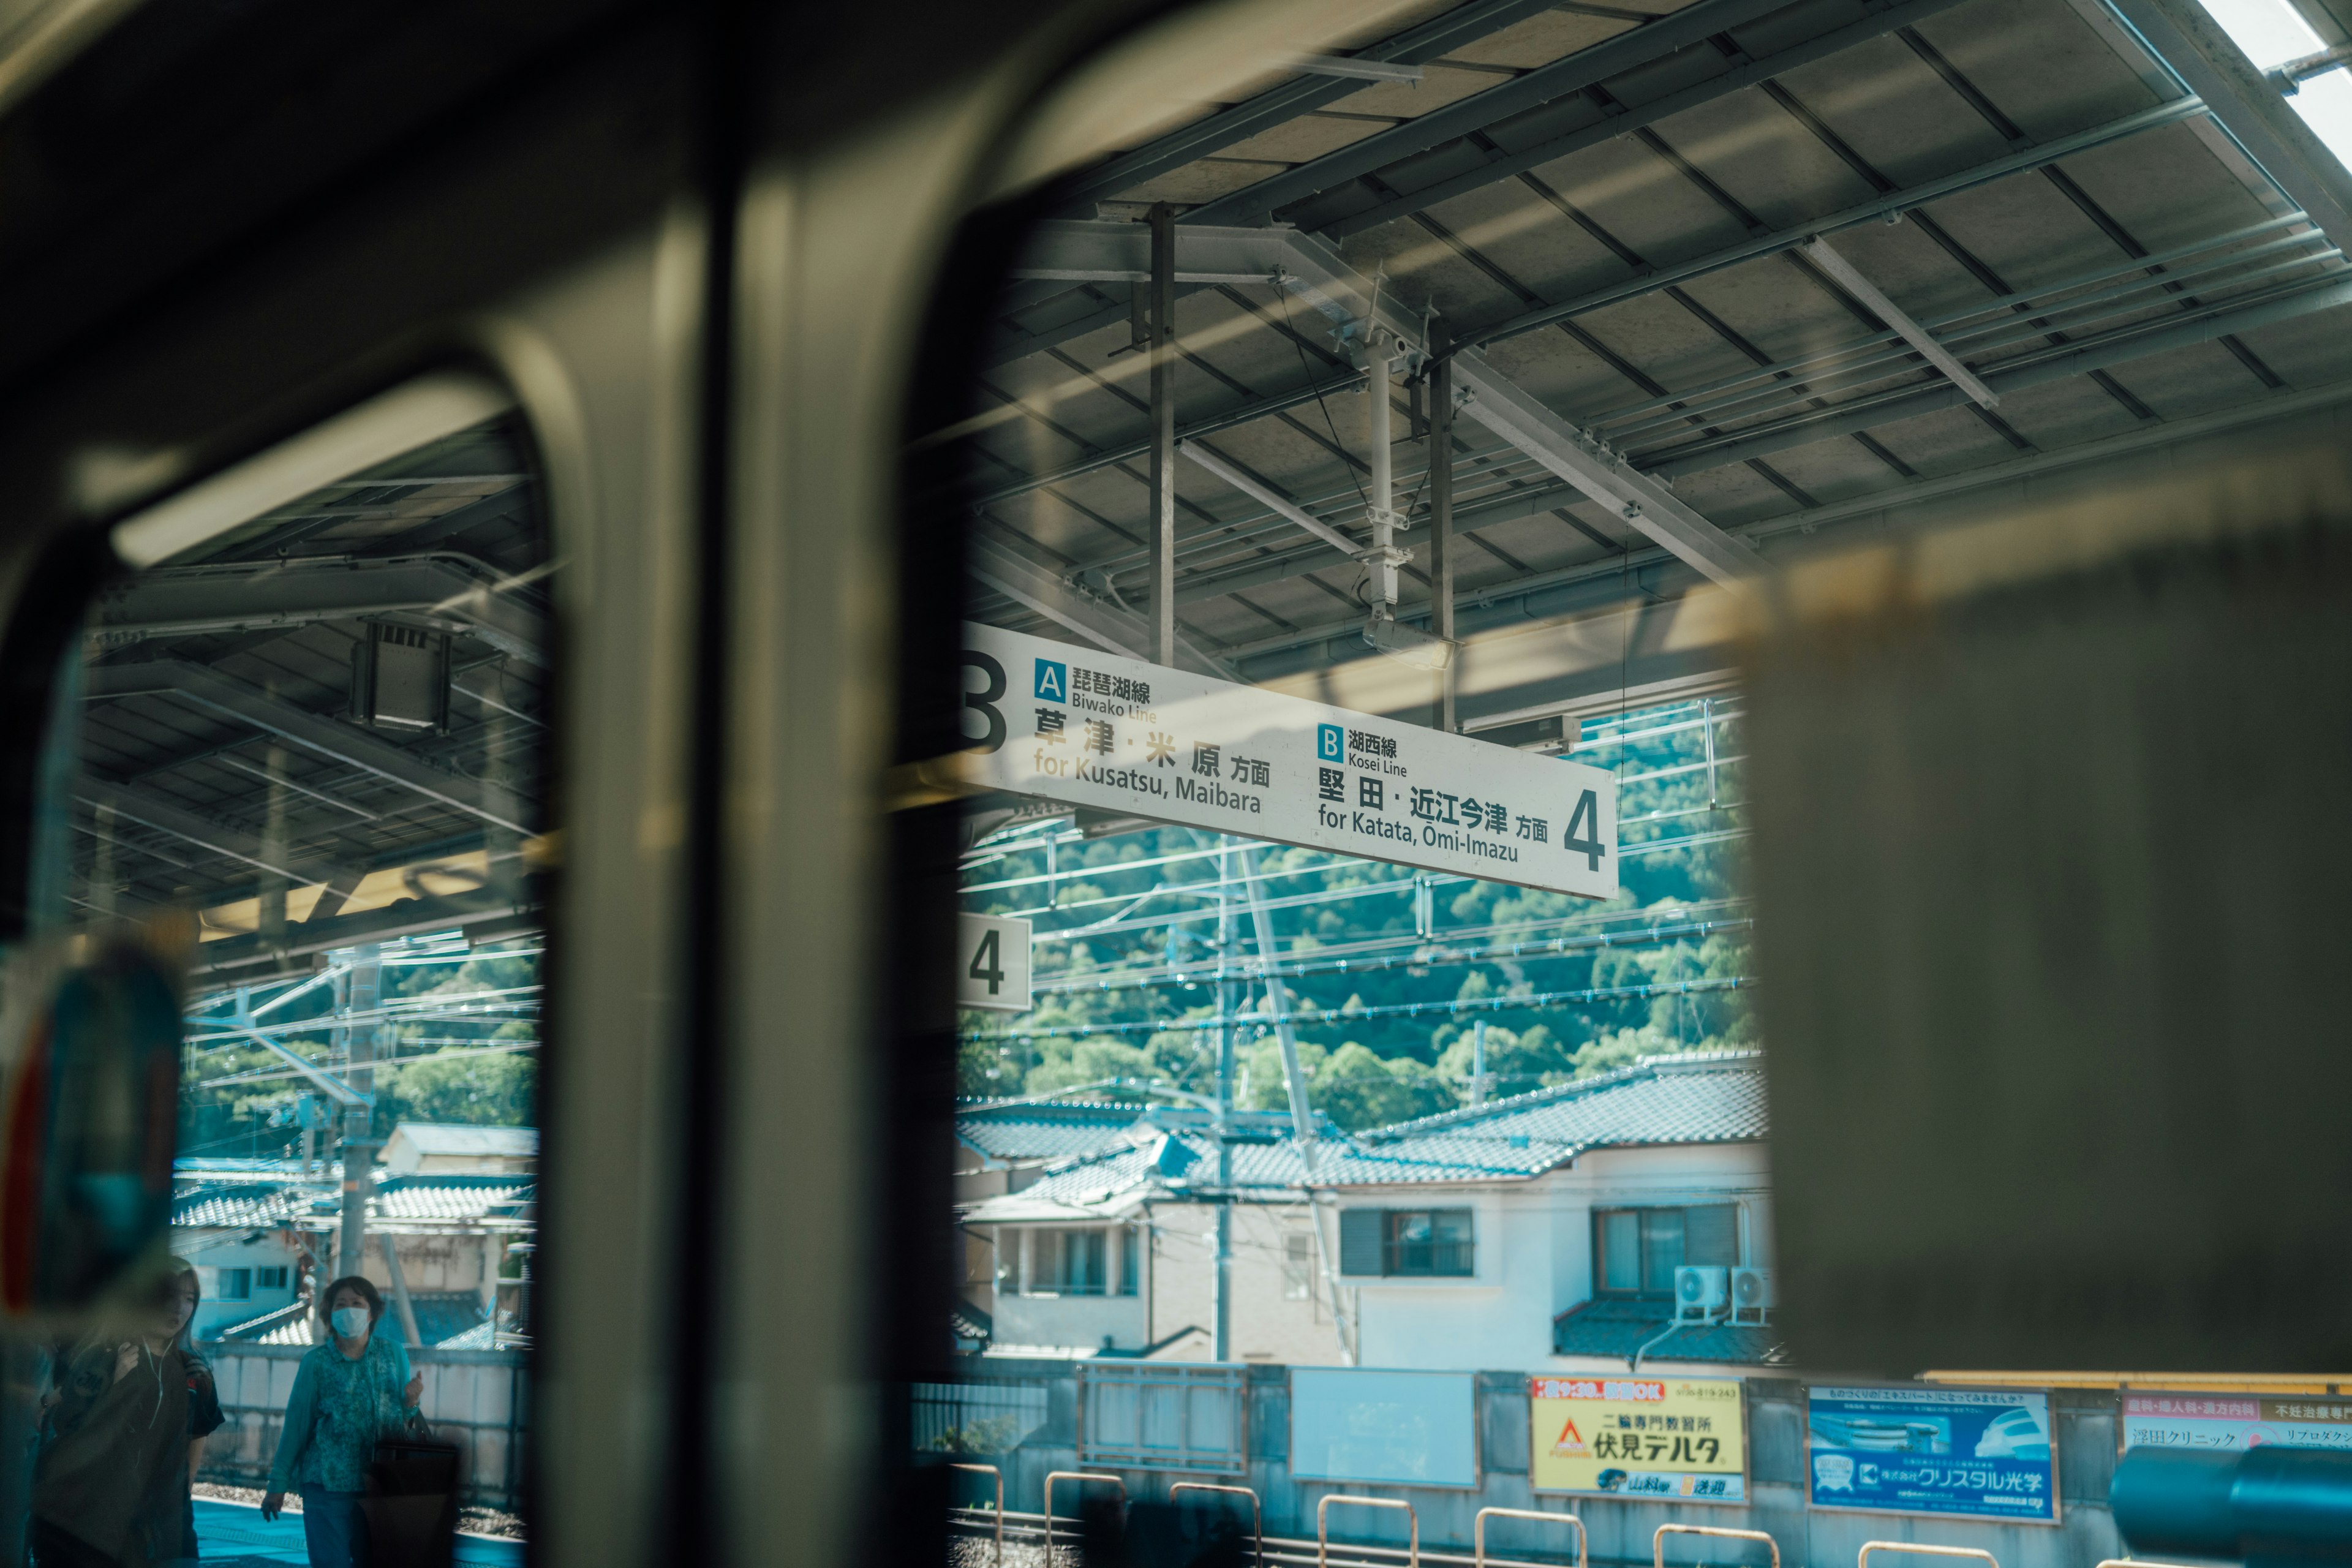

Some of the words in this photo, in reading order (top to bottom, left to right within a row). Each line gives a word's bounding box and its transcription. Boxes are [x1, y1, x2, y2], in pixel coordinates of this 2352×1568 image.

[1038, 666, 1062, 697] A
[1071, 666, 1151, 705] 琵琶湖線
[1072, 692, 1125, 717] Biwako
[1128, 705, 1157, 725] Line
[1324, 728, 1338, 757] B
[1348, 729, 1398, 760] 湖西線
[1033, 748, 1069, 777] for
[1075, 756, 1169, 799] Kusatsu,
[1175, 776, 1262, 814] Maibara
[1348, 752, 1381, 772] Kosei
[1384, 760, 1408, 778] Line
[1318, 802, 1348, 830] for
[1352, 812, 1417, 846] Katata,
[1563, 788, 1606, 873] 4
[970, 930, 1005, 995] 4
[1594, 1431, 1720, 1464] 伏見デルタ
[2132, 1428, 2236, 1447] 浮田クリニック
